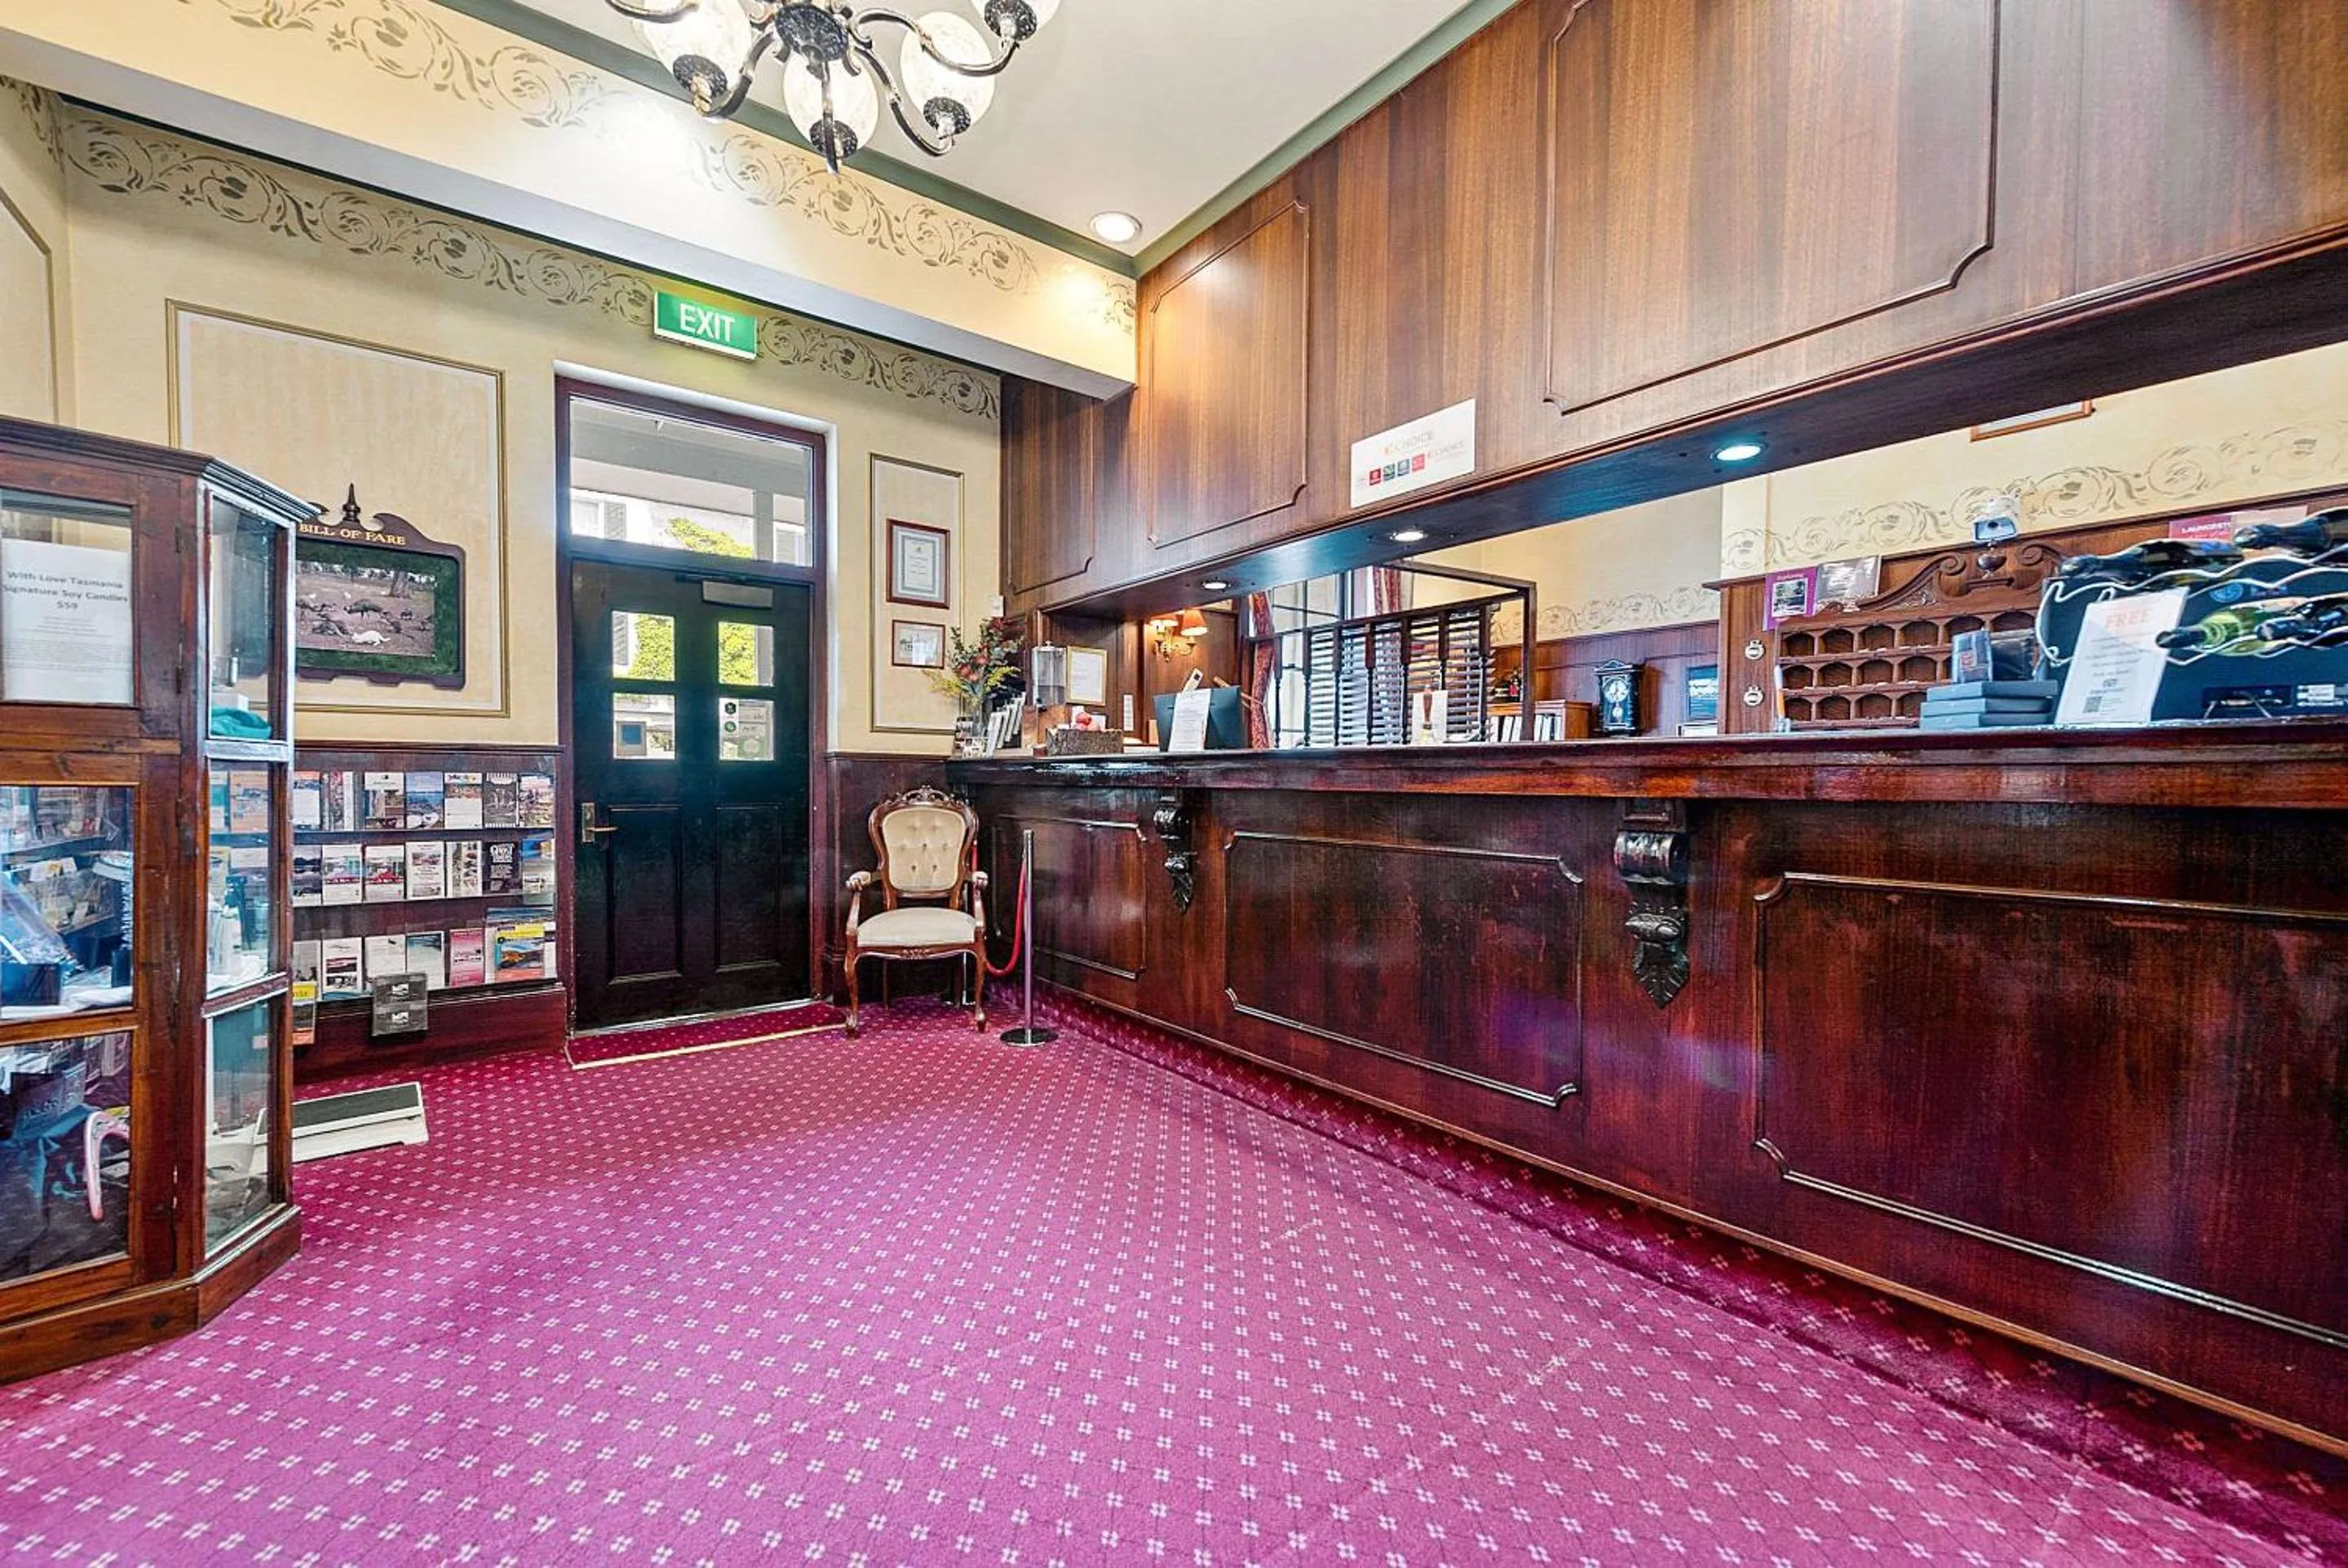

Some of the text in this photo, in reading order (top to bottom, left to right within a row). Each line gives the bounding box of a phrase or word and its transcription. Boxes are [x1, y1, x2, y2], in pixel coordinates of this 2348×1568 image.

[680, 303, 736, 342] EXIT
[299, 523, 406, 545] BILL OF FARE
[7, 571, 123, 589] With Love Tasmania
[62, 590, 82, 599] Soy
[86, 592, 128, 602] Candles
[2105, 608, 2151, 629] FREE
